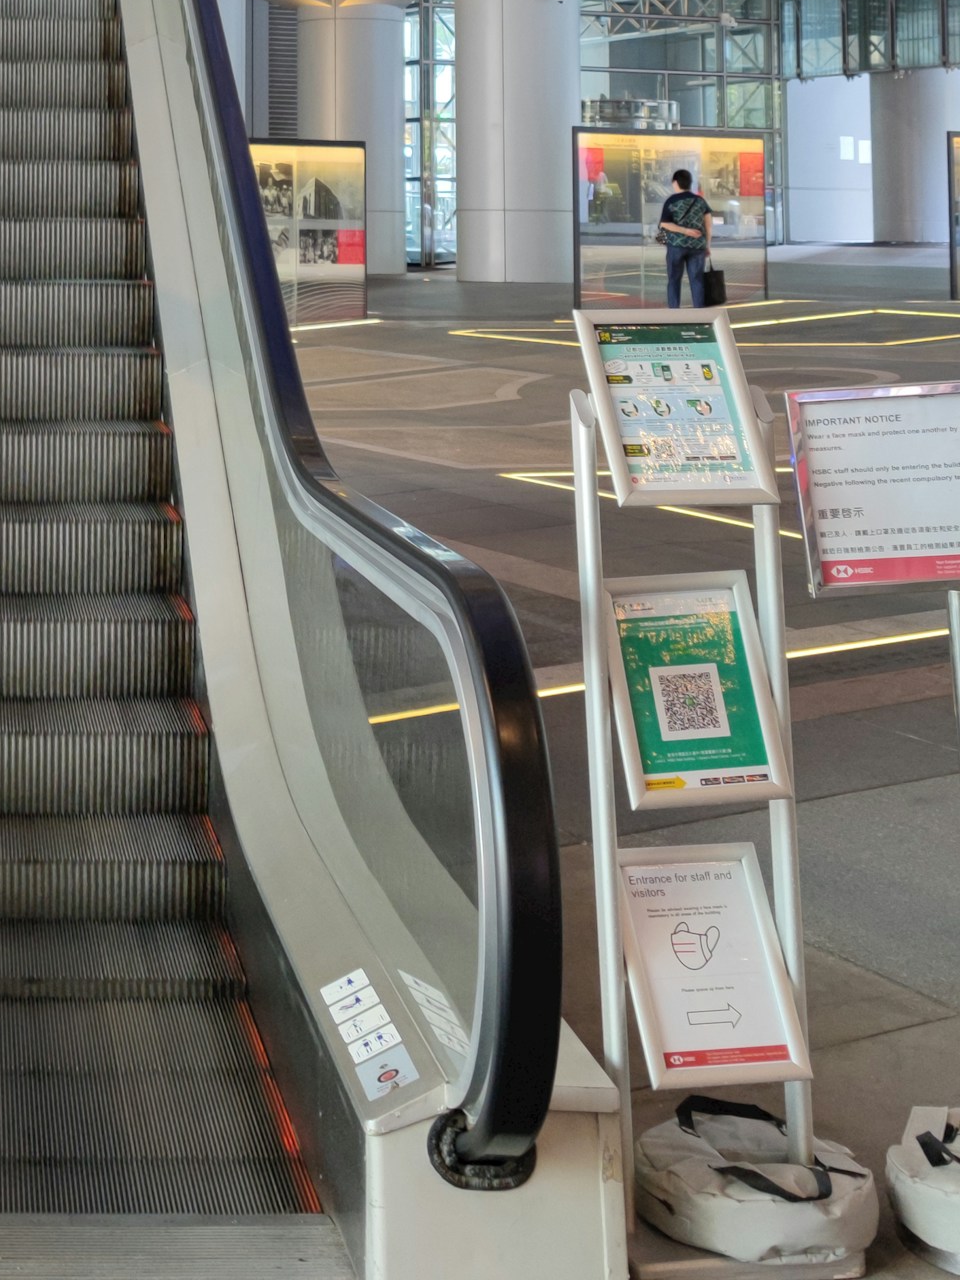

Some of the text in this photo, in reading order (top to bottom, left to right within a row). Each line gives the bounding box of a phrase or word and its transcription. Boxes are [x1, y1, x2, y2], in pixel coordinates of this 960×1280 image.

[805, 414, 902, 428] IMPORTANT NOTICE
[881, 429, 905, 437] protect
[628, 870, 732, 886] Entrance for staff and
[630, 888, 665, 897] visitors
